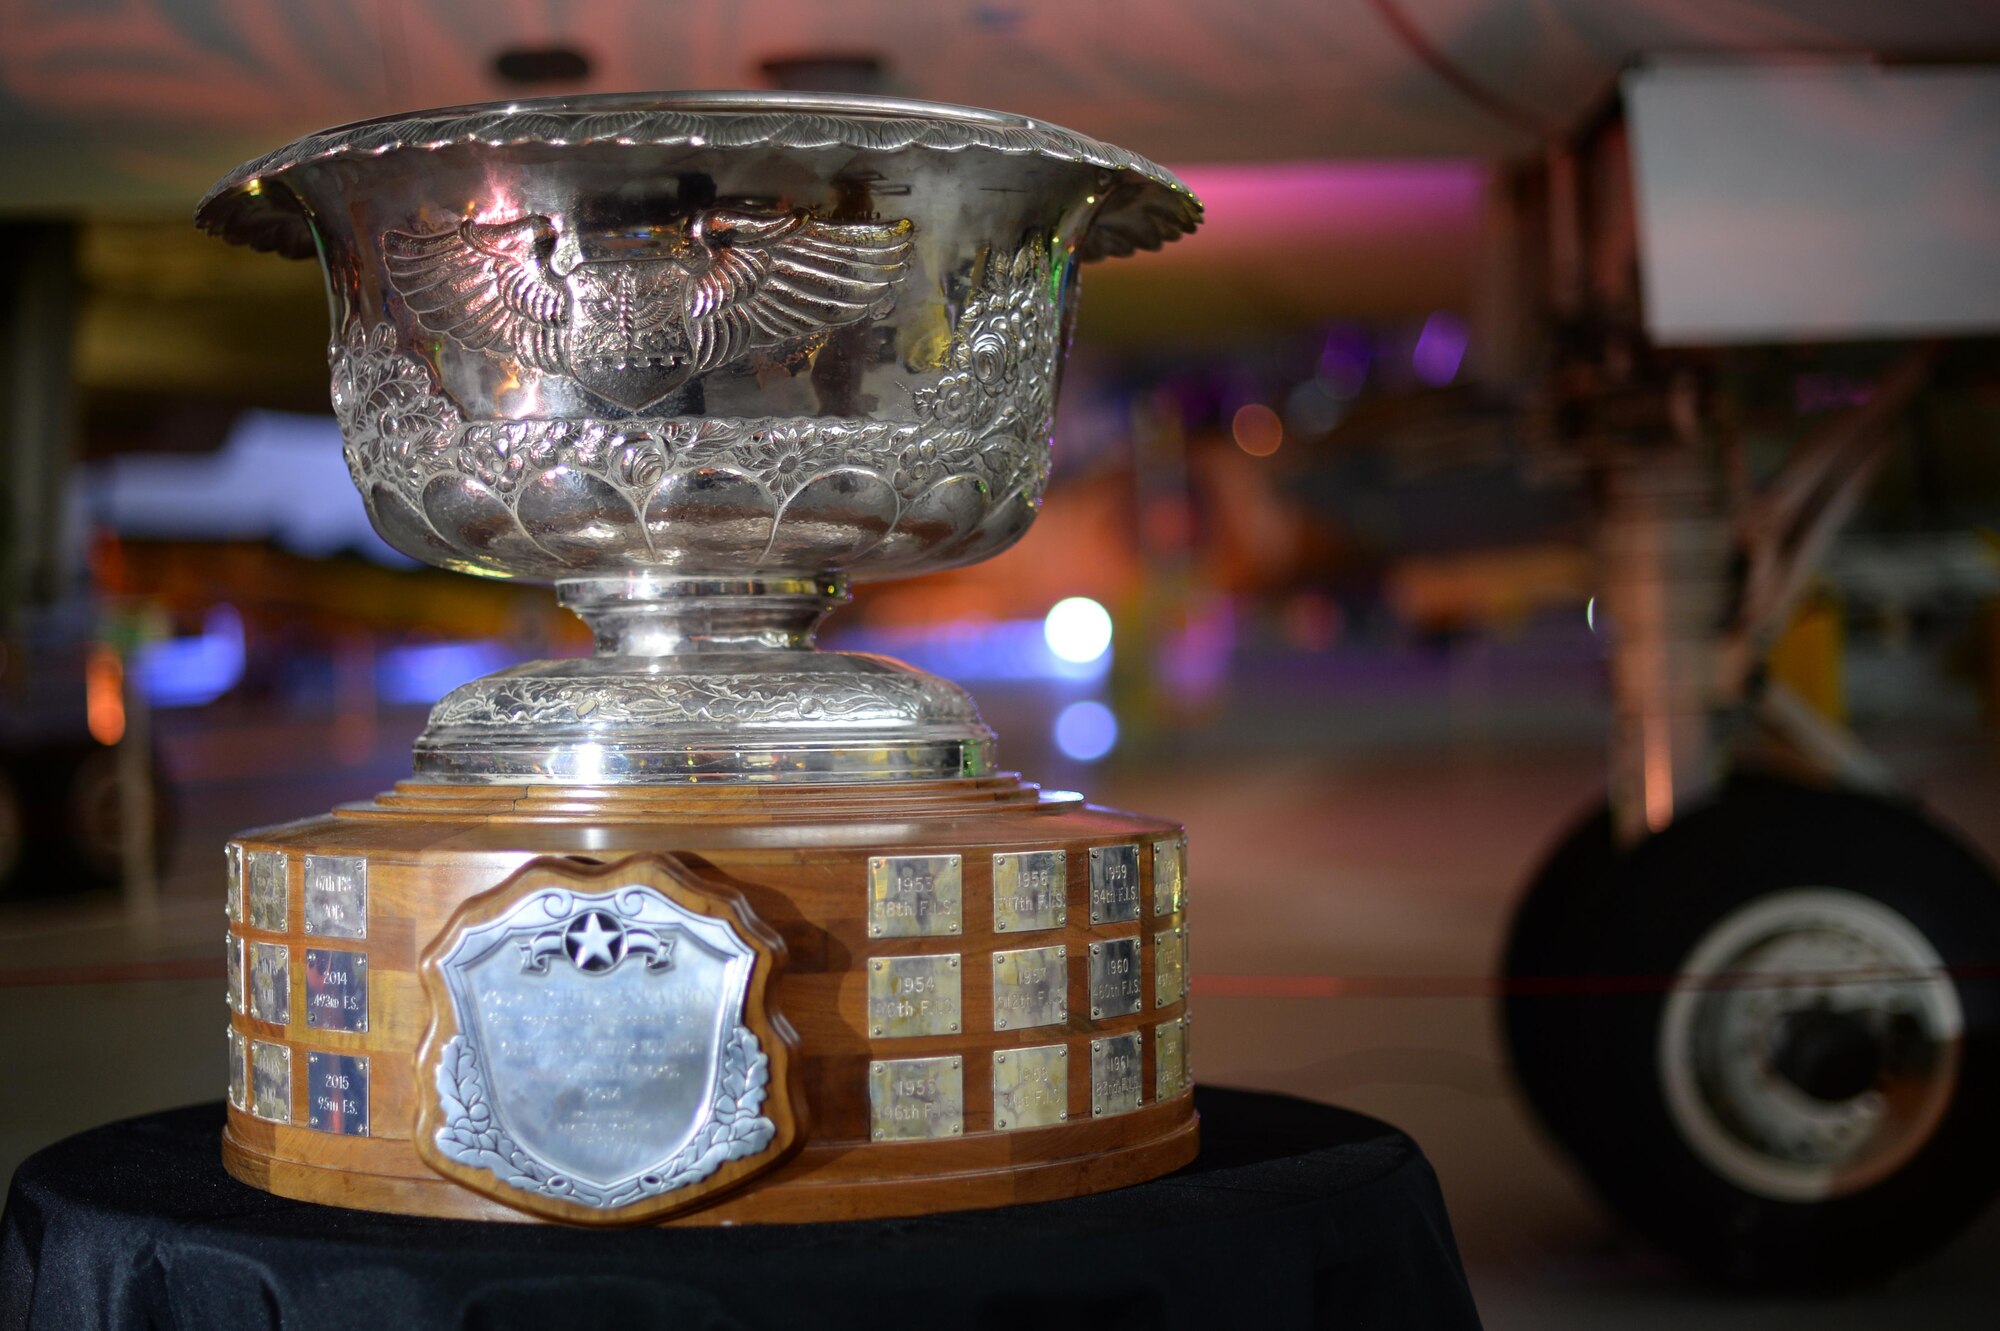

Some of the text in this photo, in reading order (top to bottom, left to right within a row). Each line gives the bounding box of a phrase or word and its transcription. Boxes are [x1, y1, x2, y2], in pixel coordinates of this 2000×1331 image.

[897, 876, 935, 893] 1953
[1018, 870, 1049, 888] 1956
[1093, 889, 1116, 905] 54th
[874, 900, 913, 918] 58th
[1108, 958, 1129, 976] 1960
[323, 971, 348, 986] 2014
[899, 976, 936, 993] 1954
[343, 995, 359, 1010] F.S.
[1110, 1055, 1130, 1073] 1961
[325, 1073, 350, 1090] 2015
[898, 1079, 937, 1097] 1955
[342, 1099, 358, 1115] F.S.
